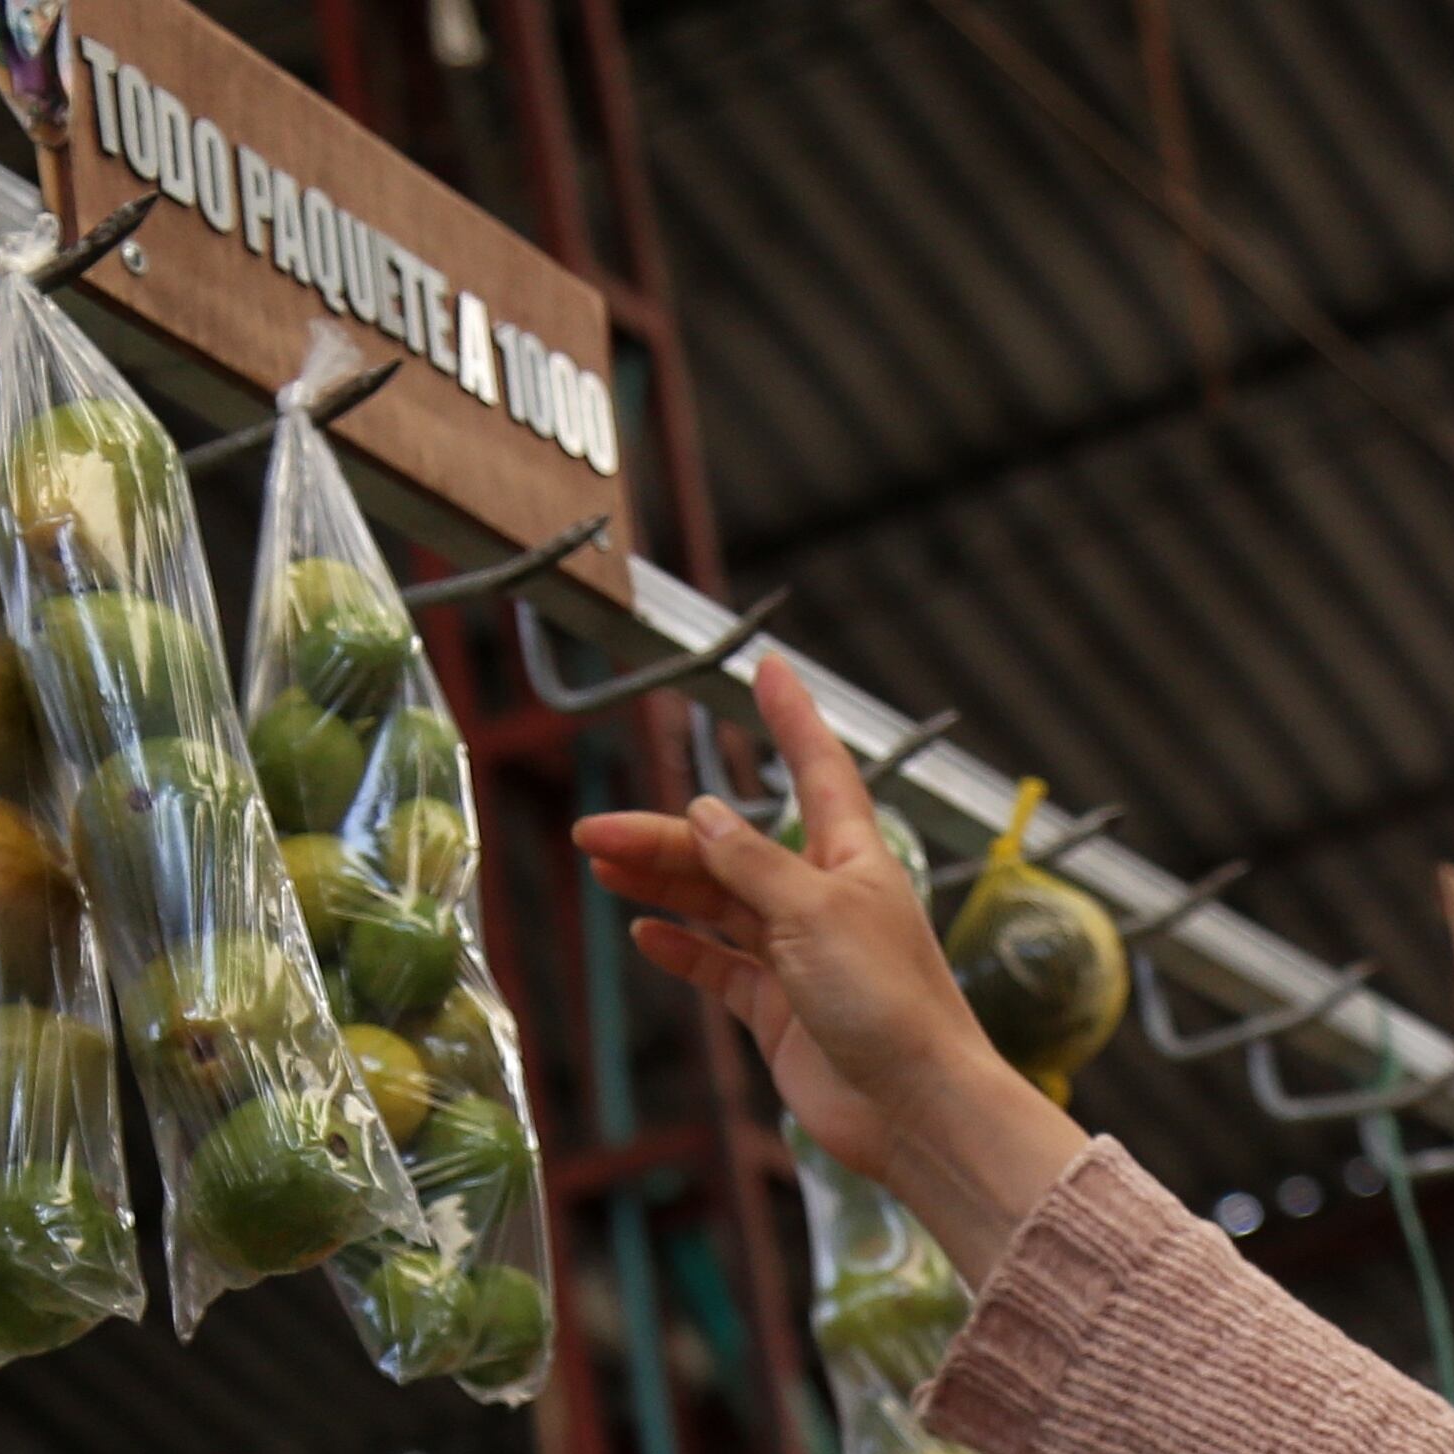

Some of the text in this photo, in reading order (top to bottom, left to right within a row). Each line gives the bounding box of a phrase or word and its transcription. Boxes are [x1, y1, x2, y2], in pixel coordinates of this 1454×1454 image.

[81, 34, 618, 476] TODO PAQUETE A 1000
